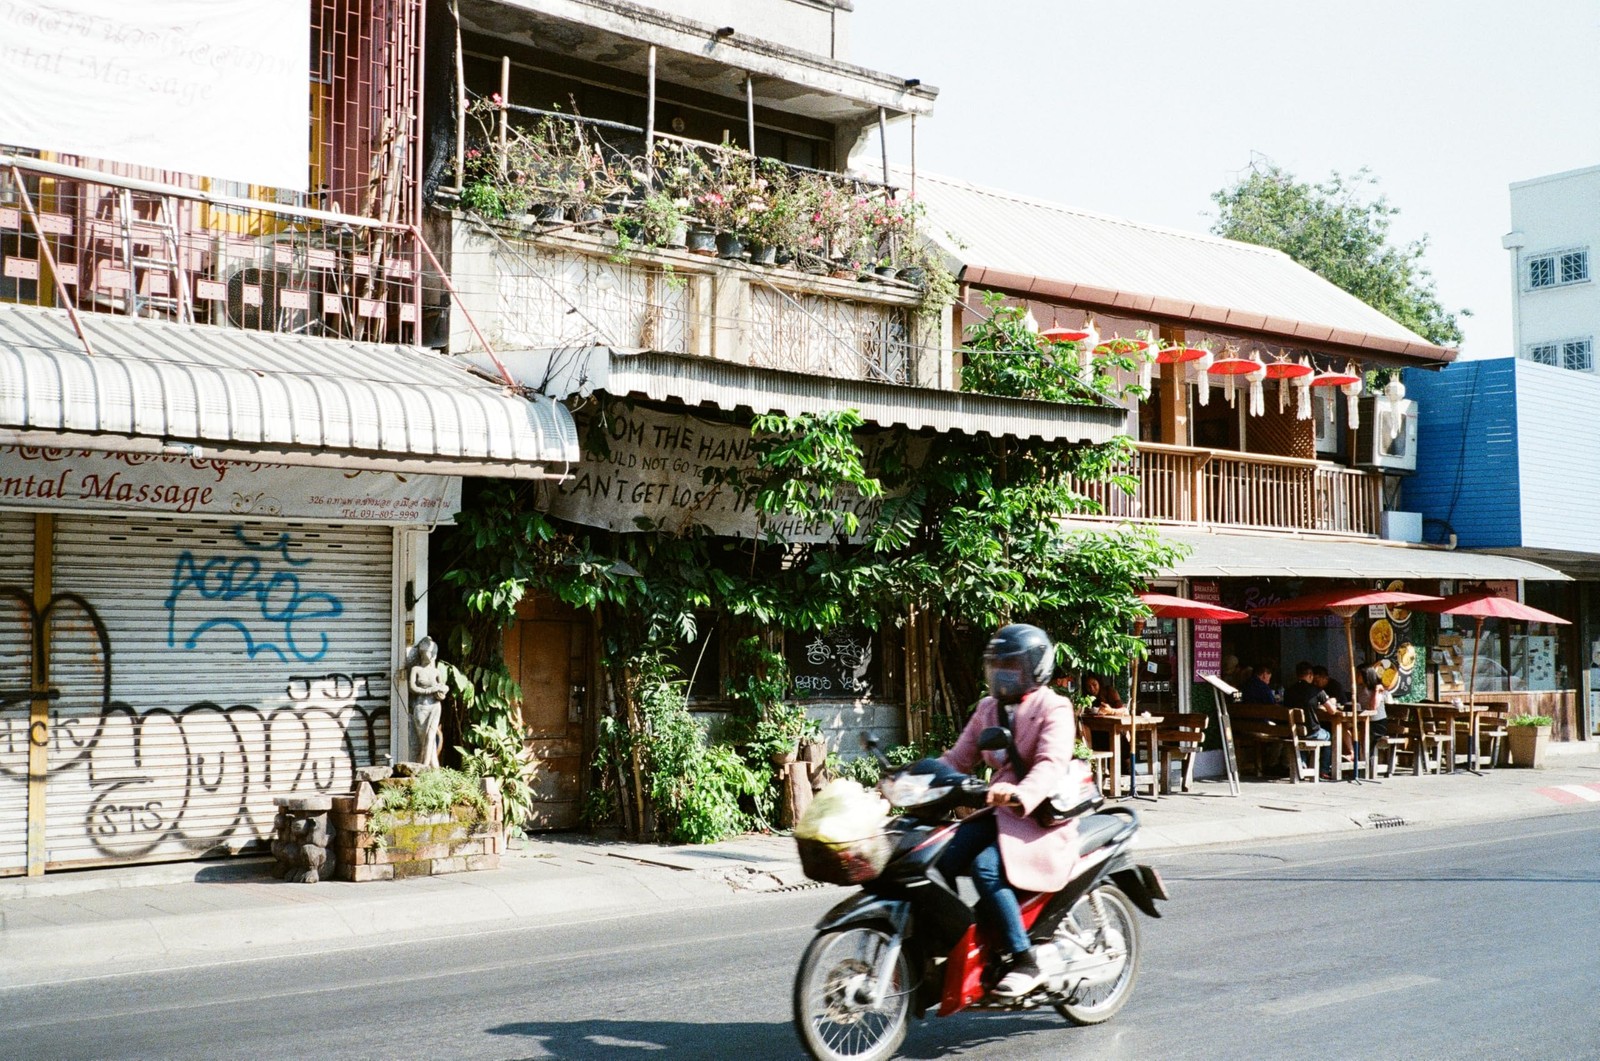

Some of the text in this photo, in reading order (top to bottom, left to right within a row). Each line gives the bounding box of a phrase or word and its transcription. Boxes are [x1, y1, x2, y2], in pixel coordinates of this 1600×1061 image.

[79, 55, 218, 108] Massage
[653, 424, 695, 452] THE
[642, 456, 669, 473] NOT
[672, 457, 690, 473] GO
[80, 472, 213, 513] Massage
[309, 496, 324, 505] 326
[631, 483, 670, 505] GET
[360, 510, 419, 519] 091-805-9990
[98, 801, 165, 837] STS
